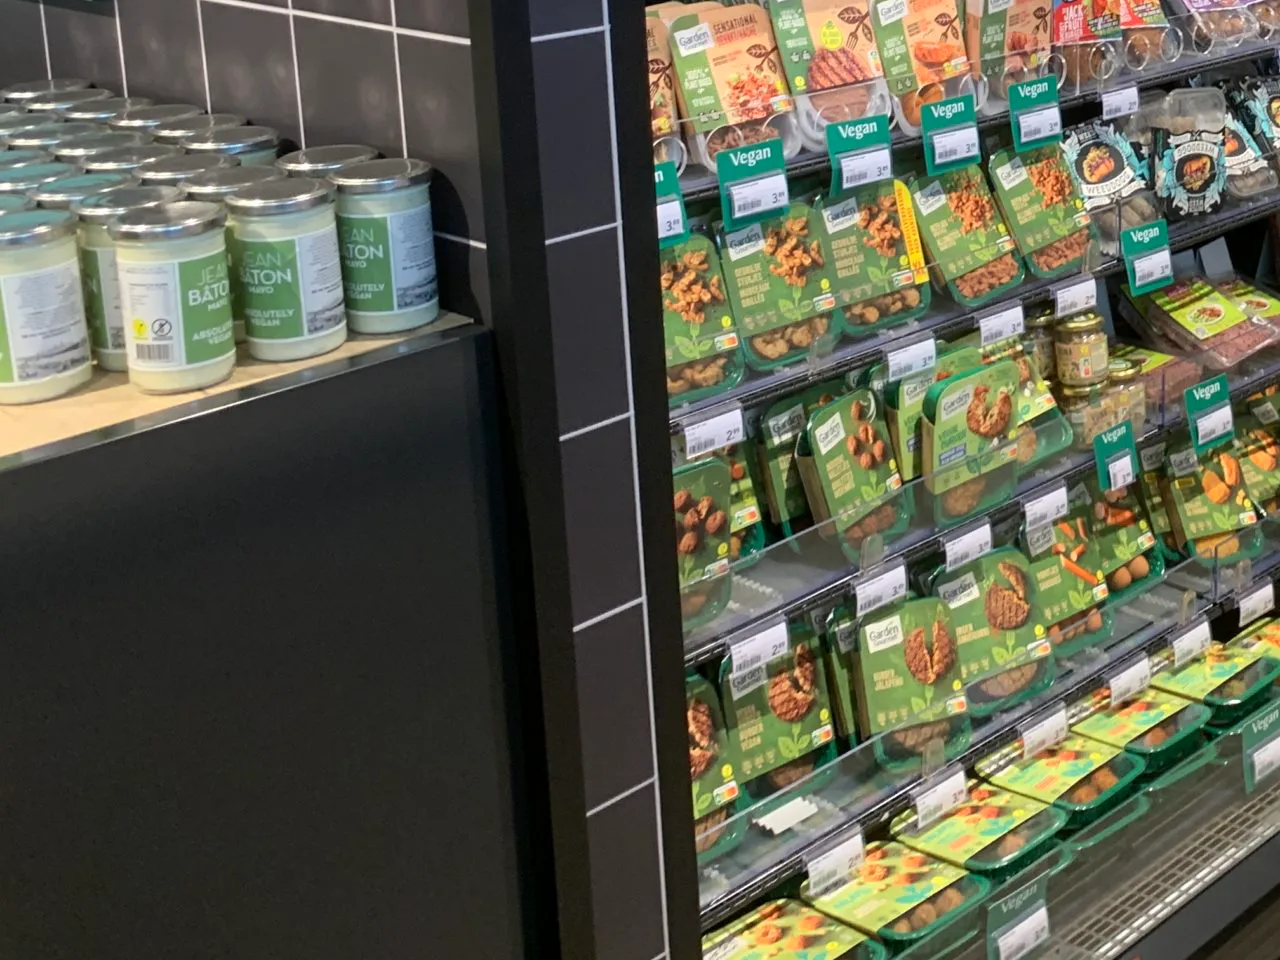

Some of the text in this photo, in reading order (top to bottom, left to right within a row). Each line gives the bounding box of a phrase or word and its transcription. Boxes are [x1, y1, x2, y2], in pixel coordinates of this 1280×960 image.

[713, 14, 758, 35] SENSATIONAL
[680, 30, 709, 47] Garden
[1018, 81, 1049, 98] Vegan
[931, 101, 965, 120] Vegan
[837, 121, 878, 141] Vegan
[729, 147, 771, 167] Vegan
[826, 205, 856, 224] Garden
[344, 227, 374, 241] EAN
[729, 231, 761, 250] Garden
[1130, 227, 1160, 243] Vegan
[243, 252, 281, 267] EAN
[188, 280, 229, 306] BÂTO
[1192, 382, 1221, 401] Vegan
[943, 391, 971, 412] Garden
[1102, 425, 1127, 444] Vegan
[943, 583, 974, 600] Garden
[870, 624, 899, 640] Garden
[732, 667, 764, 687] Garden
[1251, 709, 1280, 733] Vegan
[1001, 884, 1039, 914] Vegan
